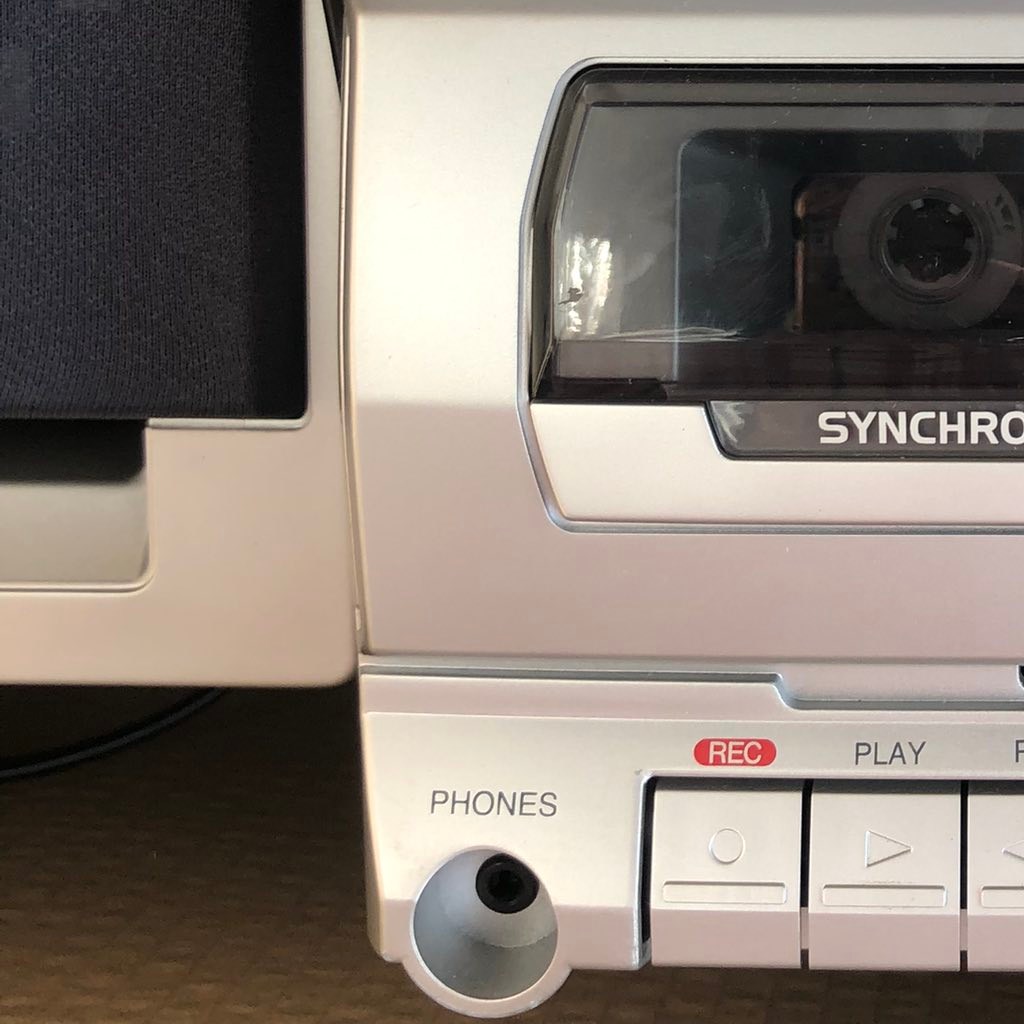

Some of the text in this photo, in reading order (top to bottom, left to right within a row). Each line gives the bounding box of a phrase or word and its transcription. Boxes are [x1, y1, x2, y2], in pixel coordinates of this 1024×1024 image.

[706, 740, 764, 765] REC
[855, 741, 926, 766] PLAY
[430, 790, 557, 817] PHONES
